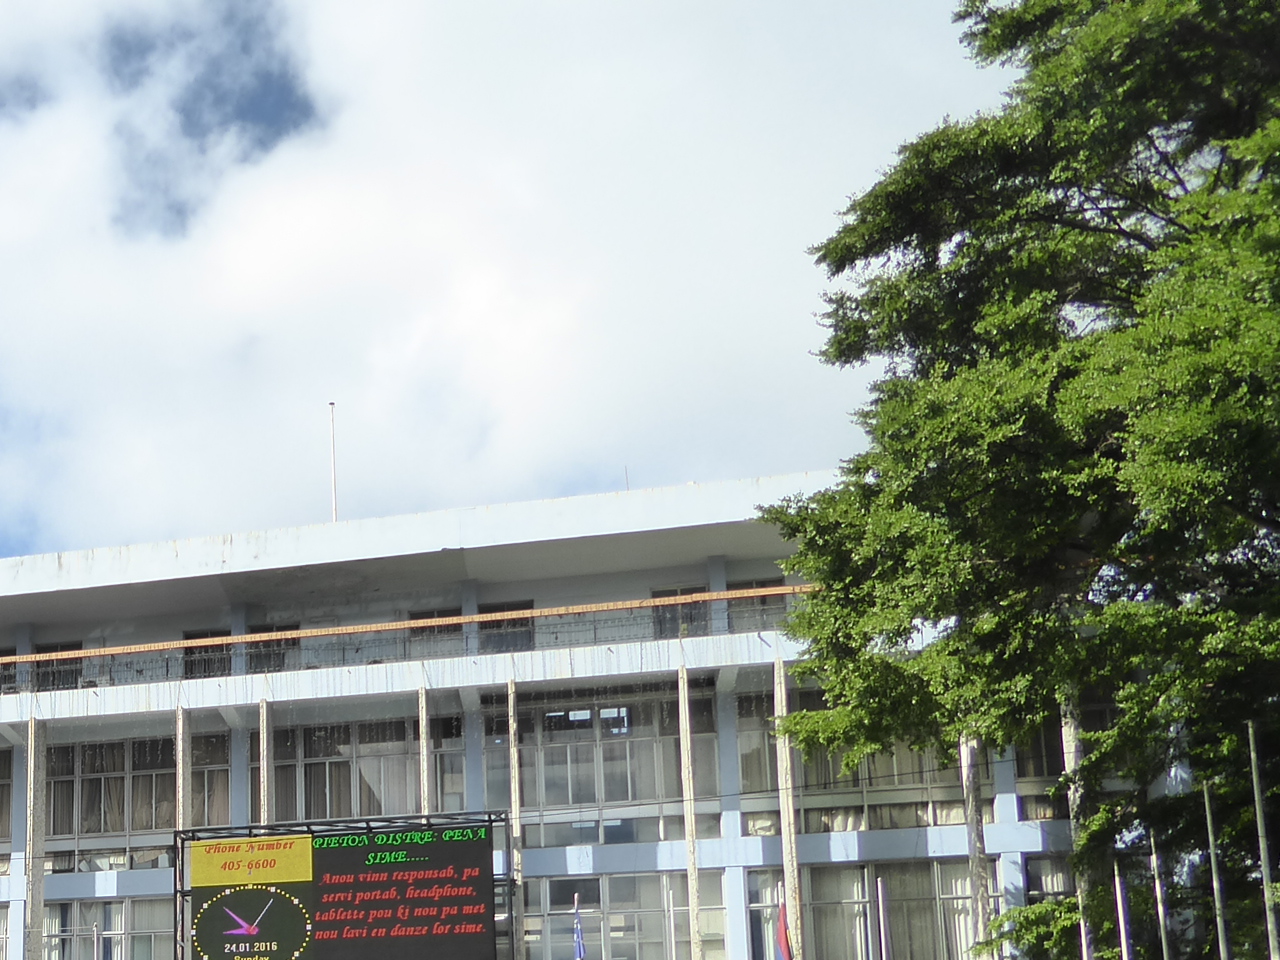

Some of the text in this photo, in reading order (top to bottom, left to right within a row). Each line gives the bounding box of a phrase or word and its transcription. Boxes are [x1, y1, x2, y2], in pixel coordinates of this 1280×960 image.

[313, 834, 373, 848] PIETON
[442, 827, 486, 841] PENA
[204, 841, 295, 854] Phone Number
[220, 858, 277, 871] 405-6600
[319, 873, 354, 886] Anou
[358, 871, 388, 882] vinn
[461, 867, 480, 880] pa
[321, 891, 352, 902] servi
[315, 908, 365, 921] tablette
[369, 910, 392, 922] pou
[413, 906, 438, 917] nou
[440, 906, 458, 919] pa
[462, 903, 486, 914] met
[315, 929, 338, 940] nou
[342, 926, 367, 938] lavi
[371, 927, 387, 937] en
[391, 924, 428, 936] danze
[224, 942, 278, 953] 24.01.2016
